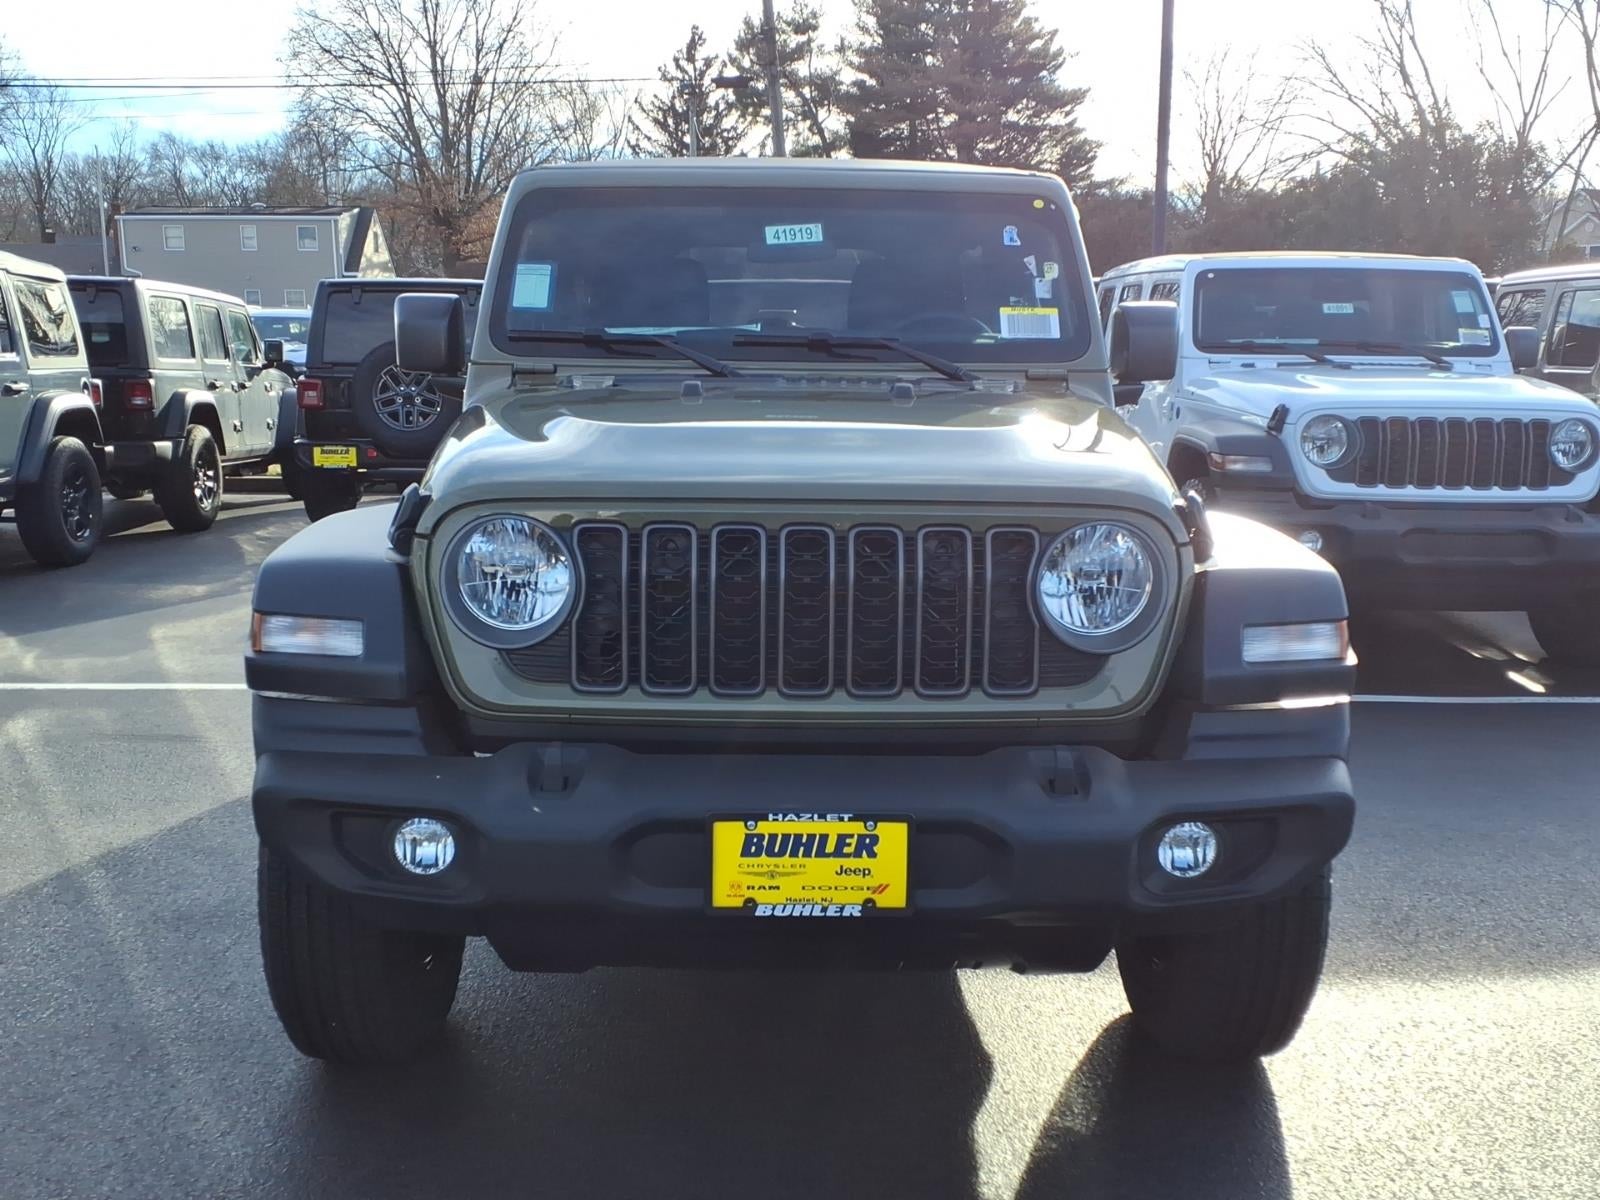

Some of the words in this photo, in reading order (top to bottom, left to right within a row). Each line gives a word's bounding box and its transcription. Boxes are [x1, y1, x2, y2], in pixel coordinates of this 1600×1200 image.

[773, 226, 813, 241] 41919
[768, 813, 853, 822] HAZLET
[740, 833, 880, 858] BUHLER
[835, 865, 871, 878] Jeep
[755, 904, 862, 917] BUHLER
